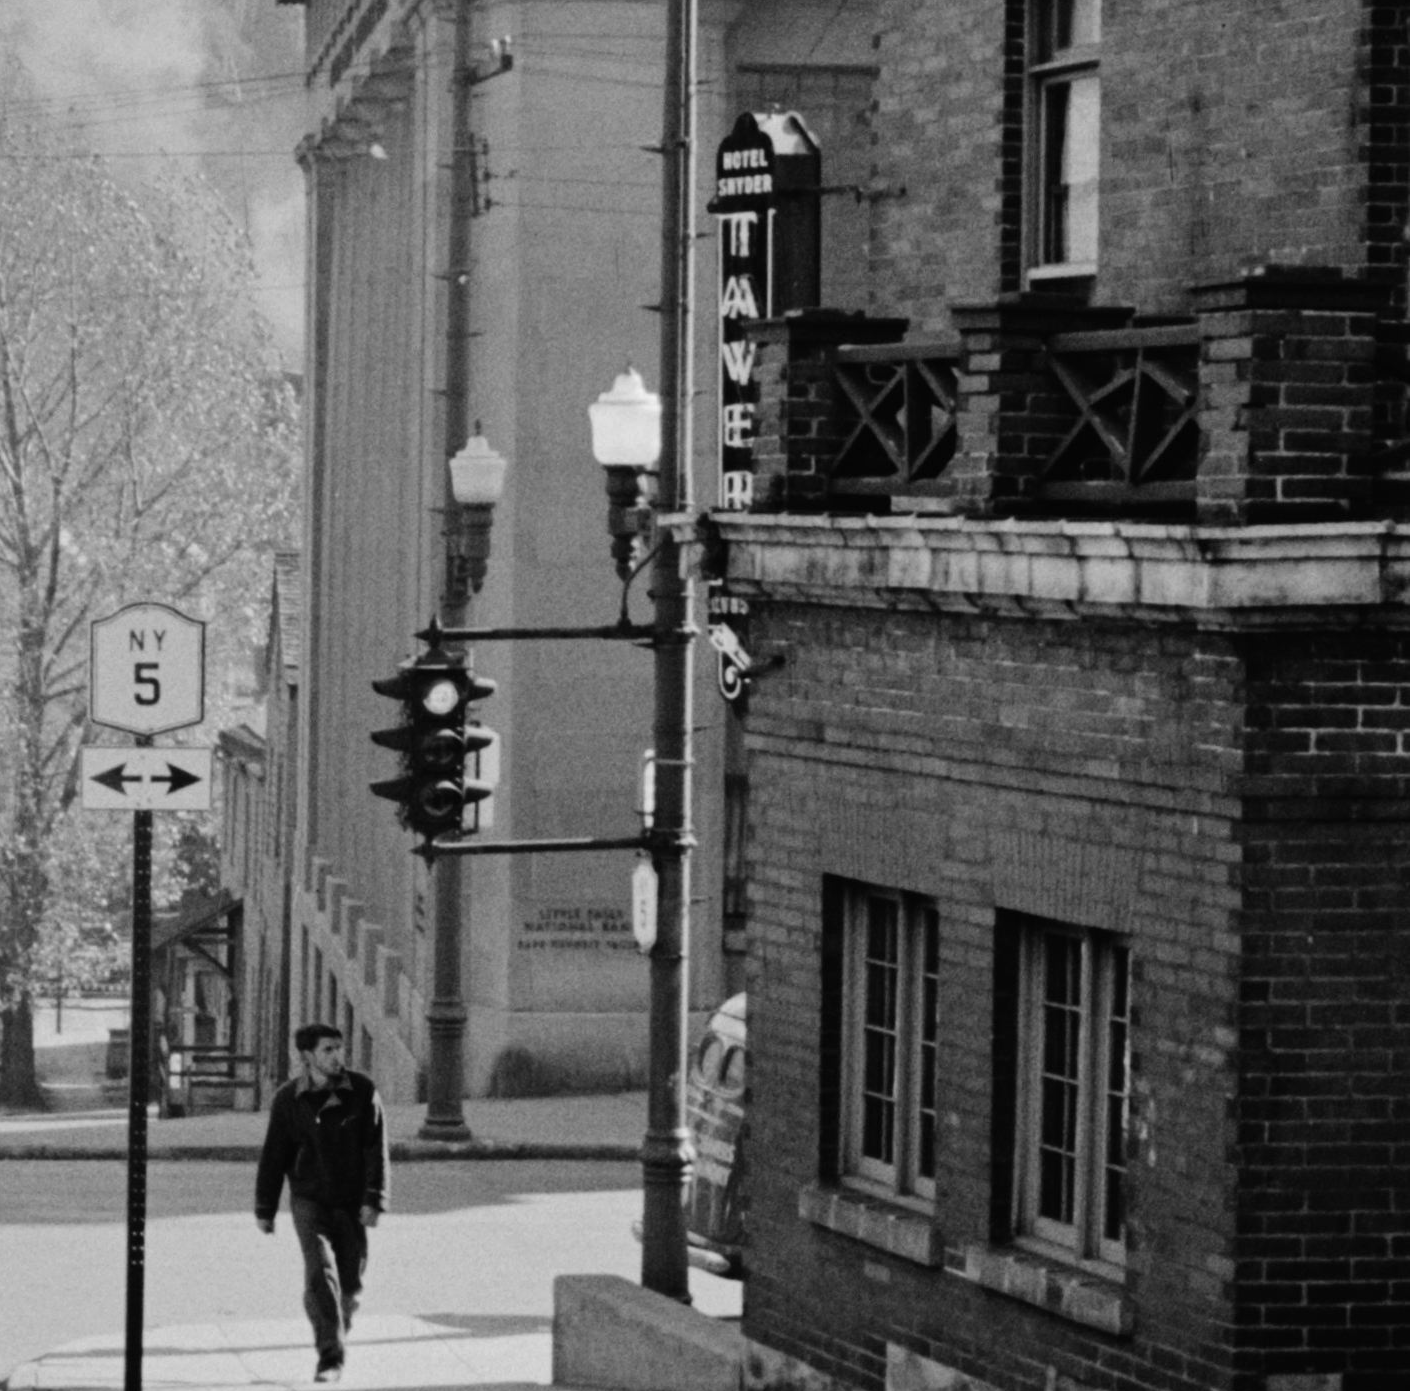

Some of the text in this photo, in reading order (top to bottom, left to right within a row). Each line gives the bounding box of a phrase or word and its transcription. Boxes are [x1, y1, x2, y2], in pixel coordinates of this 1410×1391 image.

[722, 149, 769, 170] HOTEL
[718, 173, 773, 197] SNYDER
[129, 629, 167, 652] NY
[133, 662, 161, 706] 5
[601, 921, 633, 932] BAN
